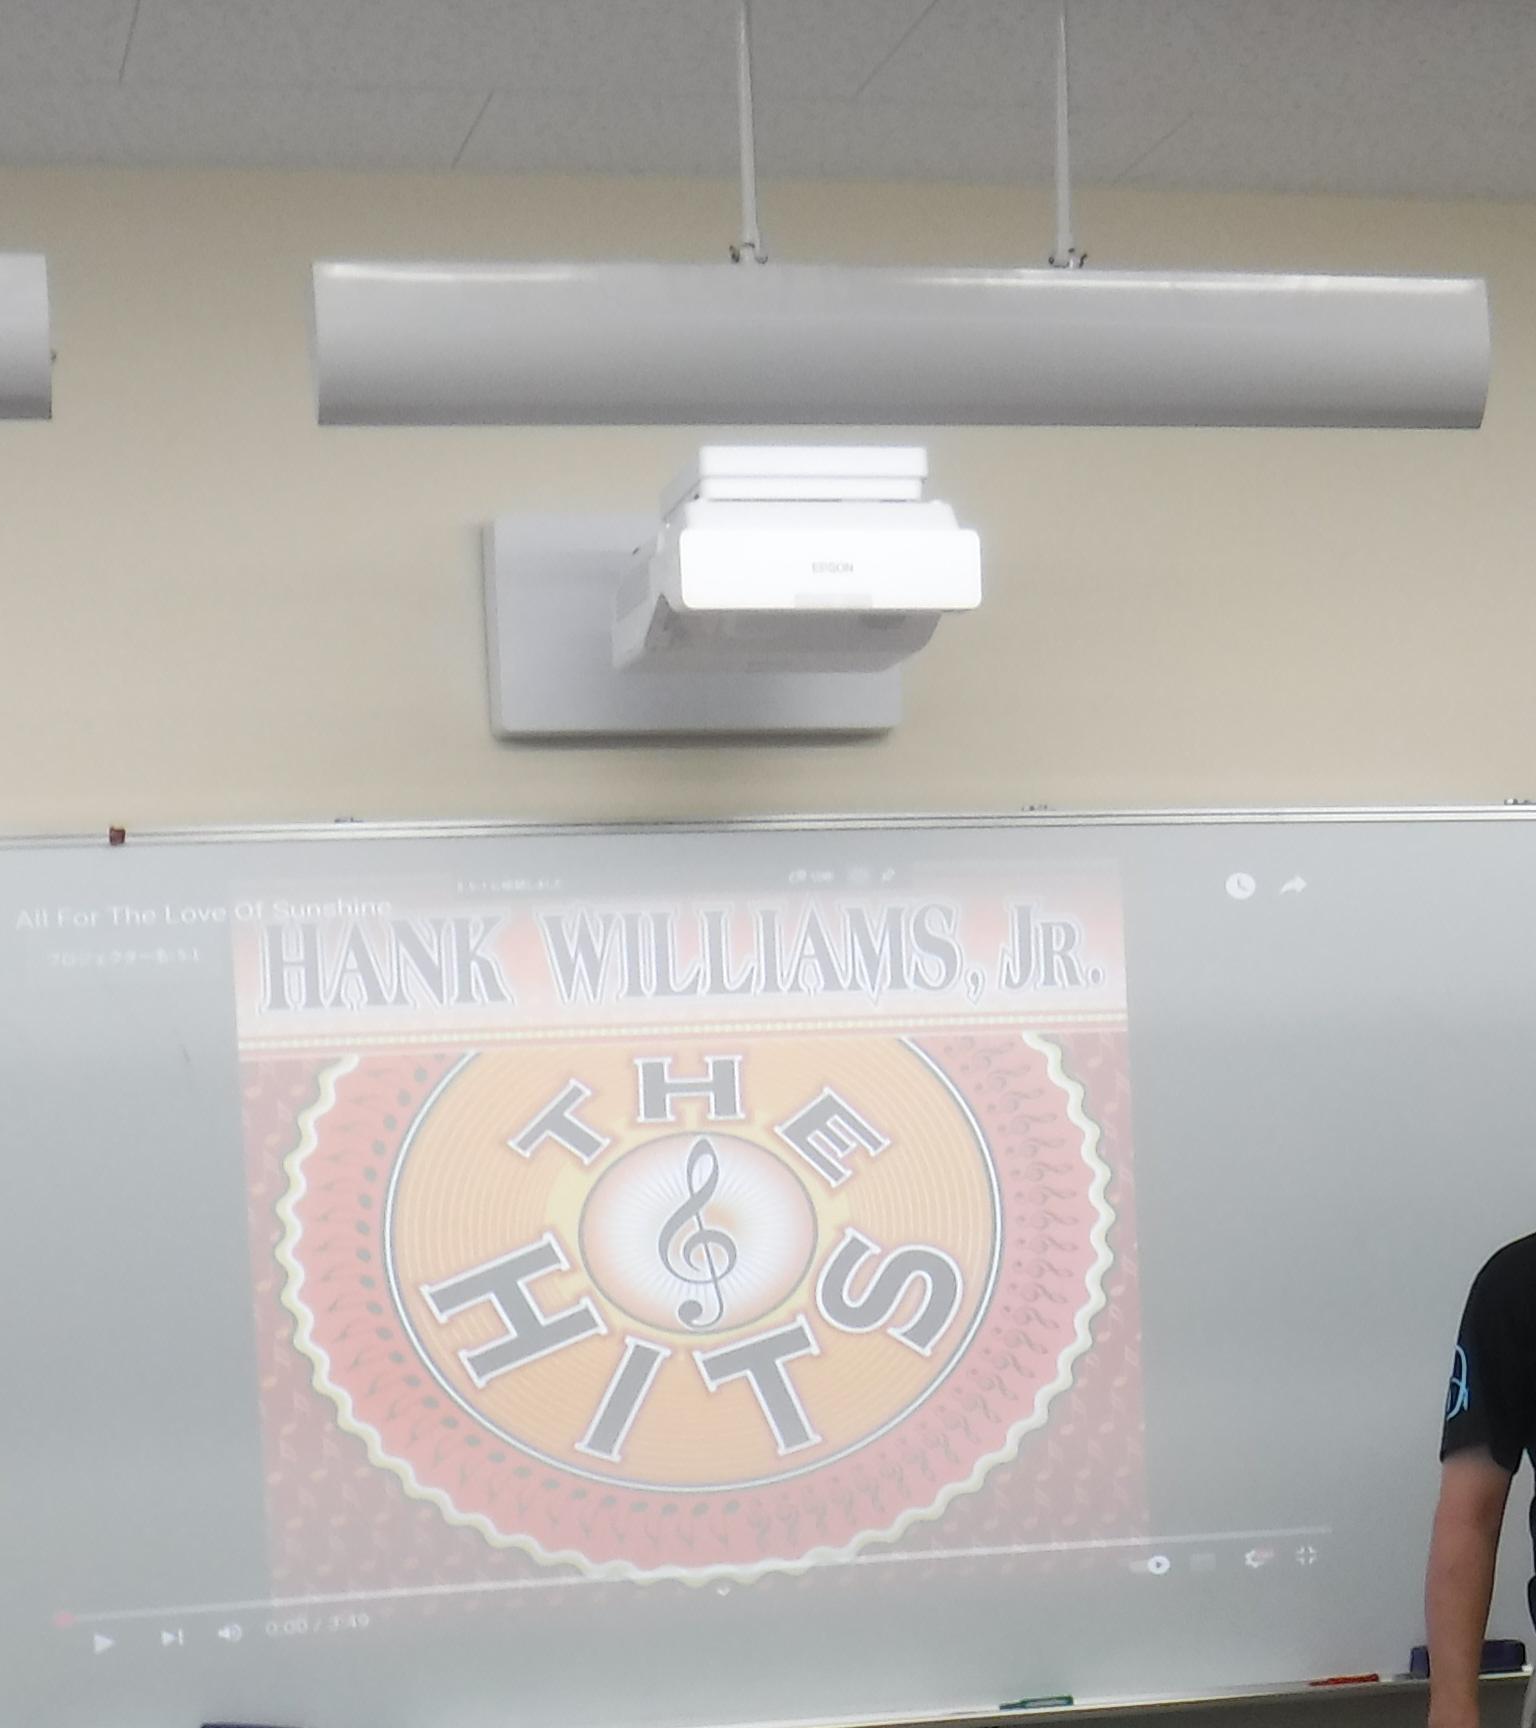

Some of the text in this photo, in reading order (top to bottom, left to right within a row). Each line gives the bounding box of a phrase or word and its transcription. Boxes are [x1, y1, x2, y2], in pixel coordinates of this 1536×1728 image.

[15, 897, 393, 930] All For The Love Of Sunshine
[260, 908, 514, 1012] HANK
[536, 895, 984, 1012] WILLIAMS,
[508, 1053, 892, 1188] THE
[420, 1228, 964, 1464] HITS
